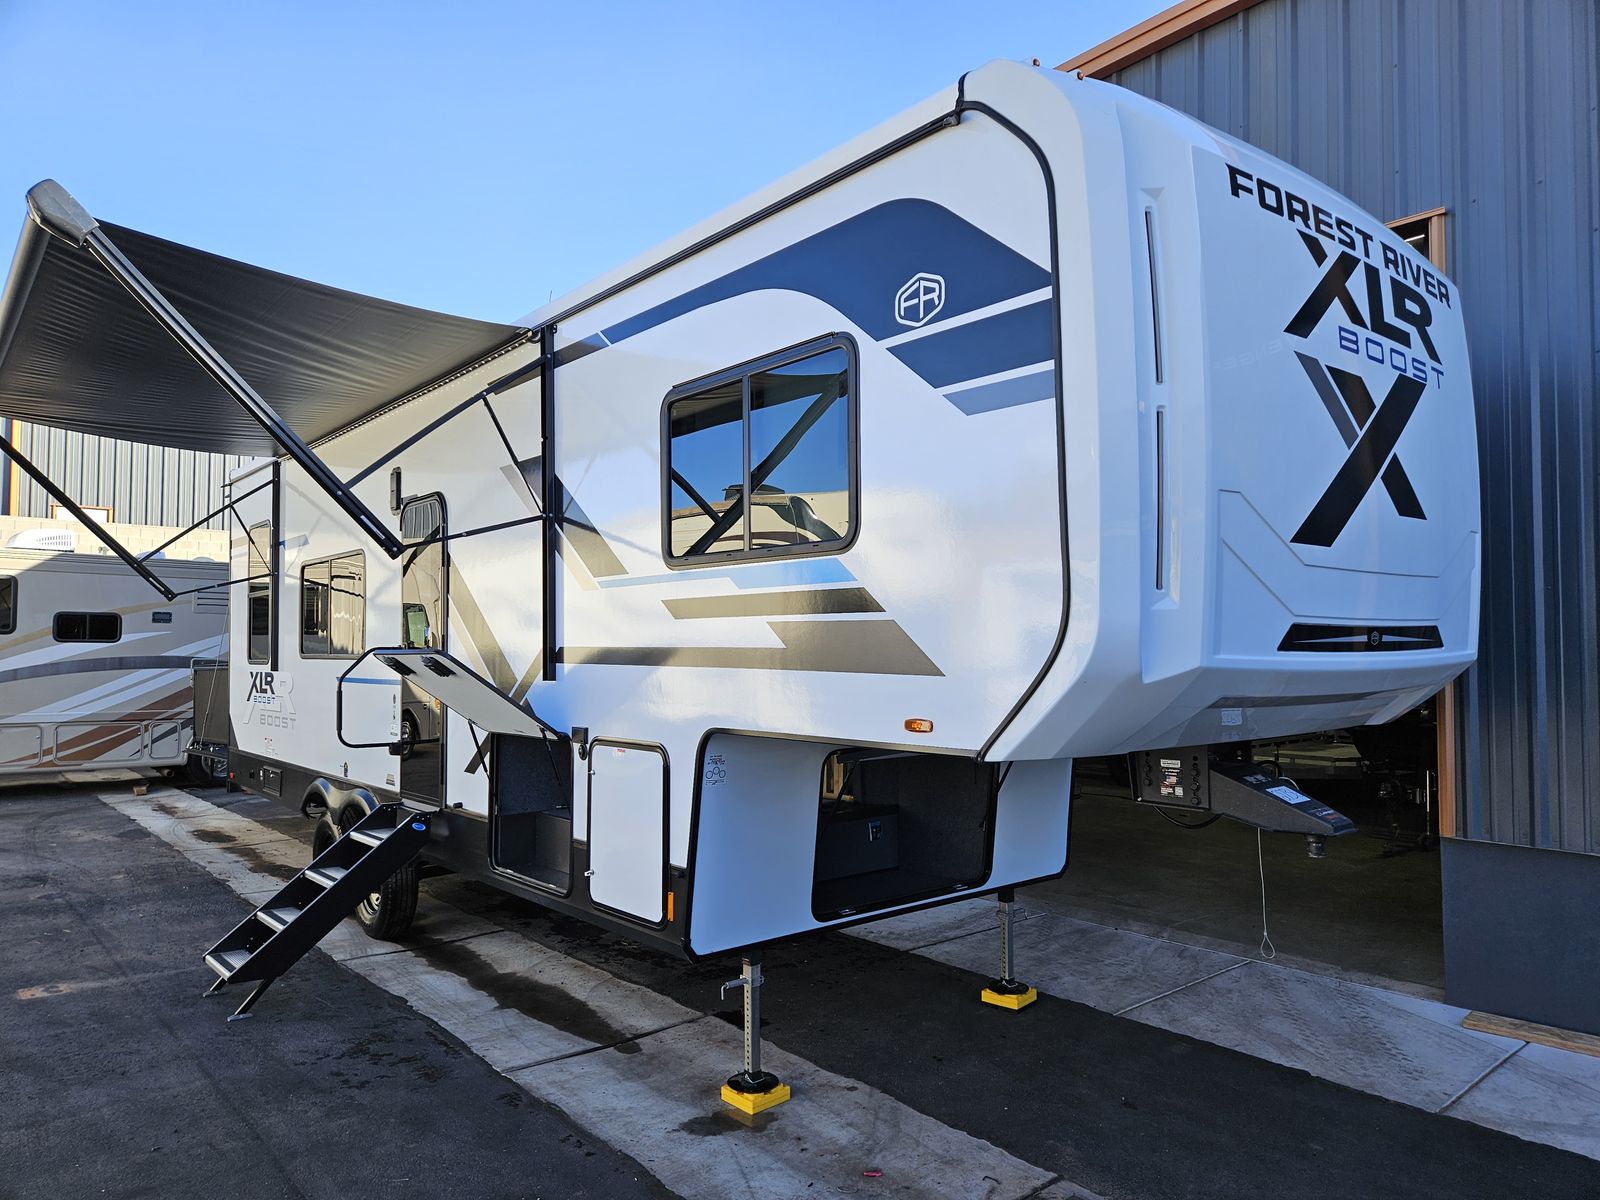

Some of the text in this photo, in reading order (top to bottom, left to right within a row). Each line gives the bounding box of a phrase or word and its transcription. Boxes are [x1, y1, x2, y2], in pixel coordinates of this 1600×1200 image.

[1224, 162, 1452, 310] FOREST RIVER
[1283, 228, 1443, 366] XLR
[1338, 325, 1445, 390] BOOST
[246, 671, 276, 702] XLR
[253, 695, 276, 705] BOOST
[260, 713, 297, 730] BOOST
